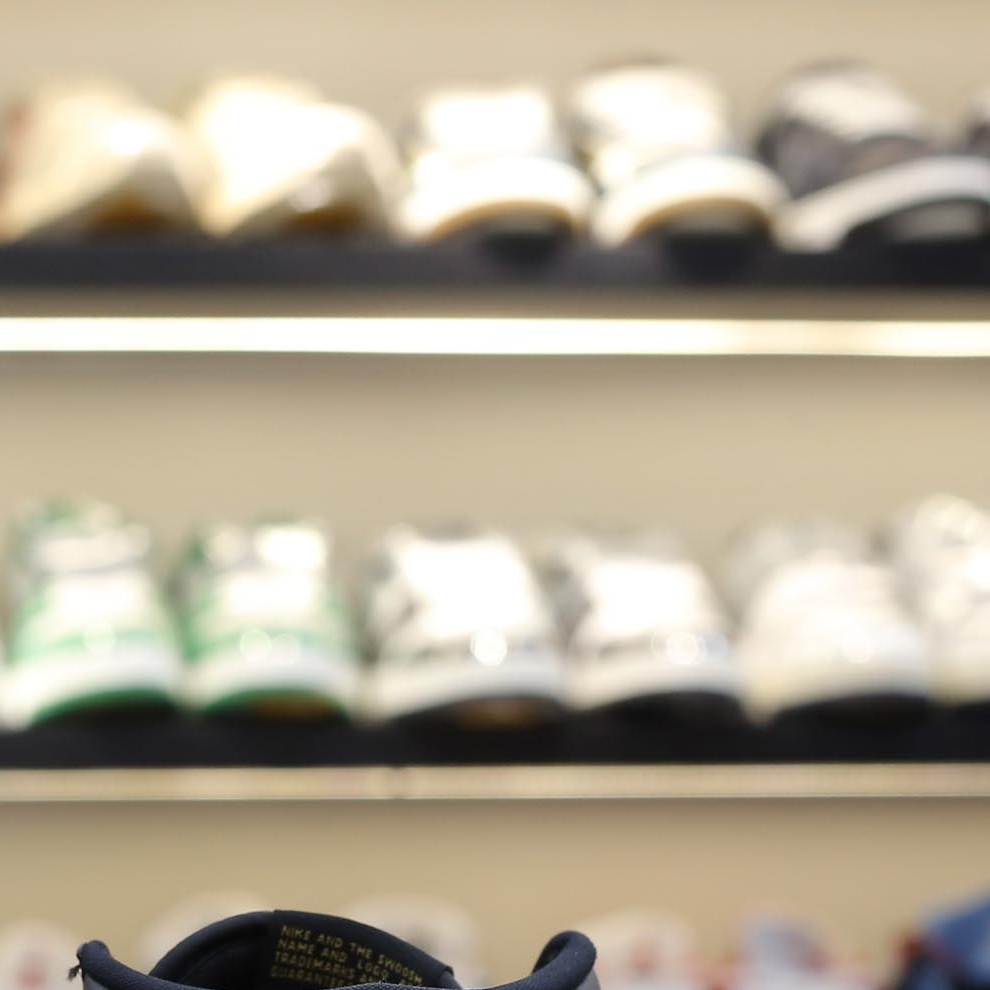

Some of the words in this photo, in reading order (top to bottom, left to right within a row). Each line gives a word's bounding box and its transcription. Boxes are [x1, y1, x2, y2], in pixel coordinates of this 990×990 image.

[278, 938, 316, 955] NAME
[321, 947, 348, 963] AND
[281, 925, 312, 941] NIKE
[316, 933, 343, 948] AND
[349, 942, 373, 959] THE
